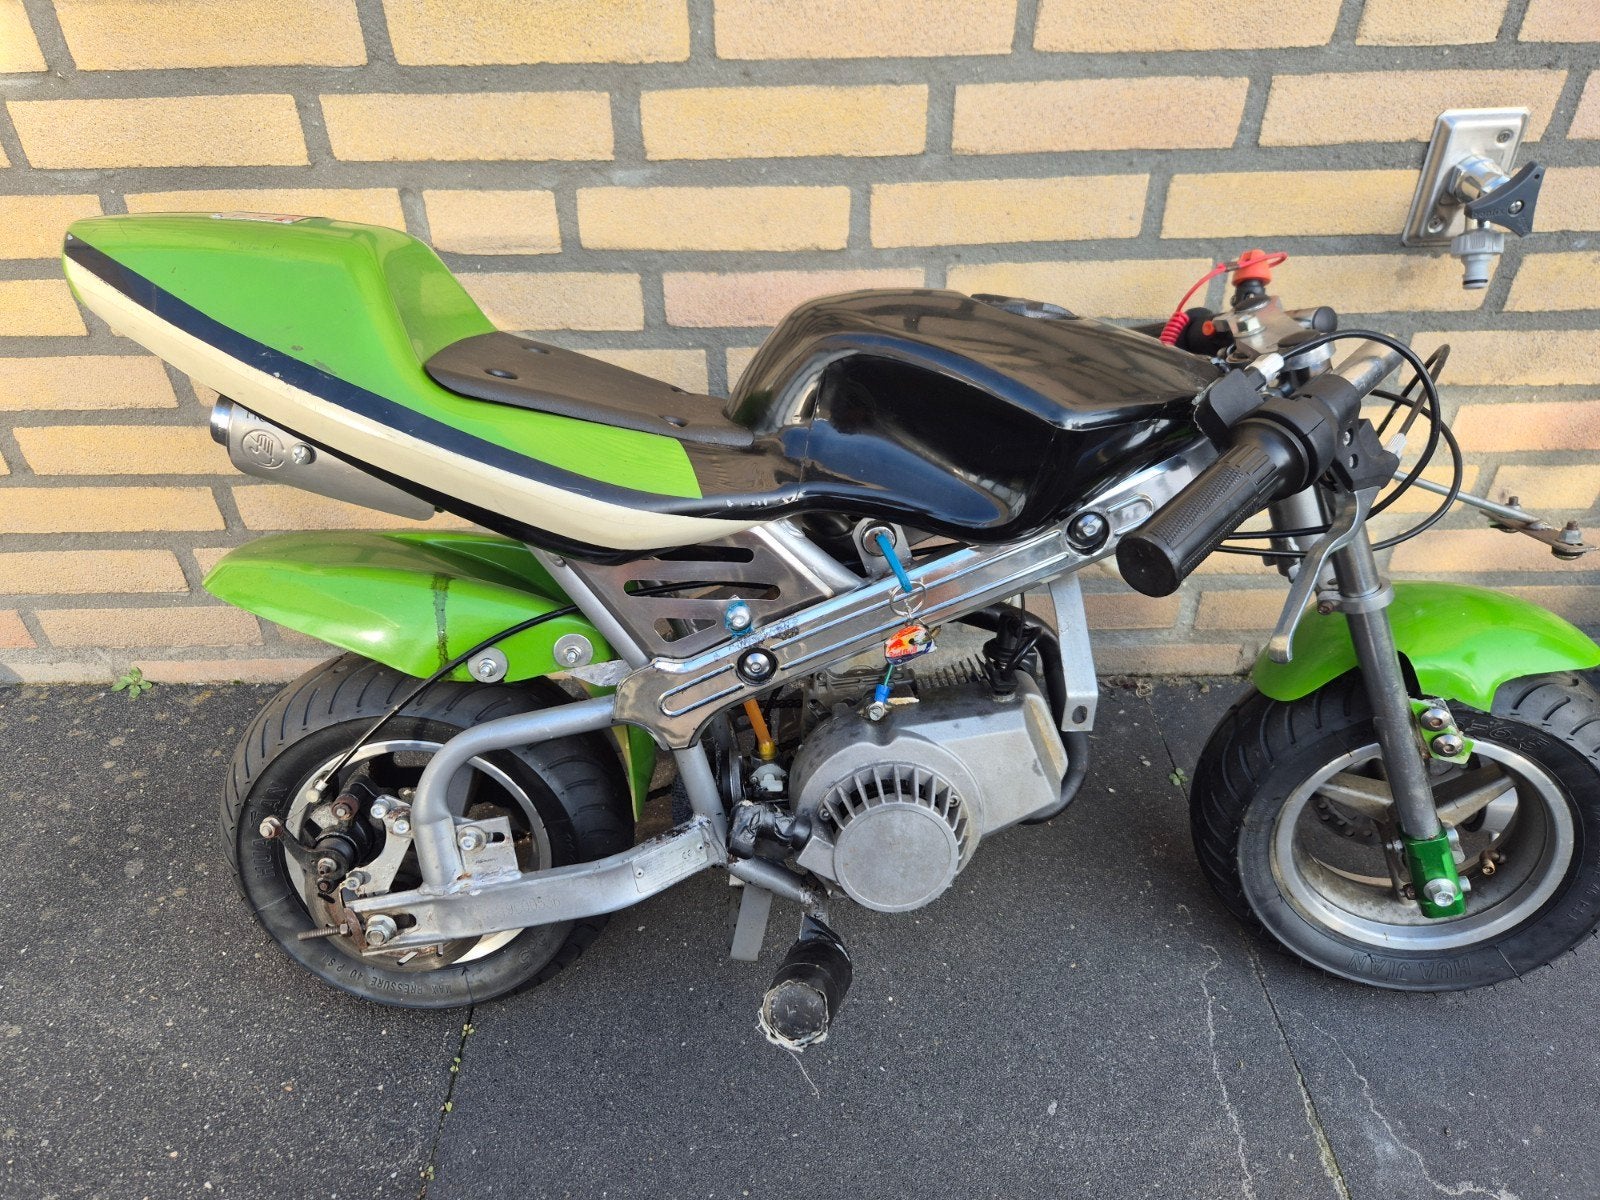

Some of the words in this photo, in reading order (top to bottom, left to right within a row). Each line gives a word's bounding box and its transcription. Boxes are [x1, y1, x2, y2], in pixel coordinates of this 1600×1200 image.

[251, 838, 277, 880] HUA
[681, 848, 693, 860] CE
[348, 969, 364, 981] 40
[1346, 952, 1411, 979] JIAN
[1416, 956, 1471, 979] HUA
[370, 976, 423, 995] PRESSURE
[431, 984, 453, 996] MAX
